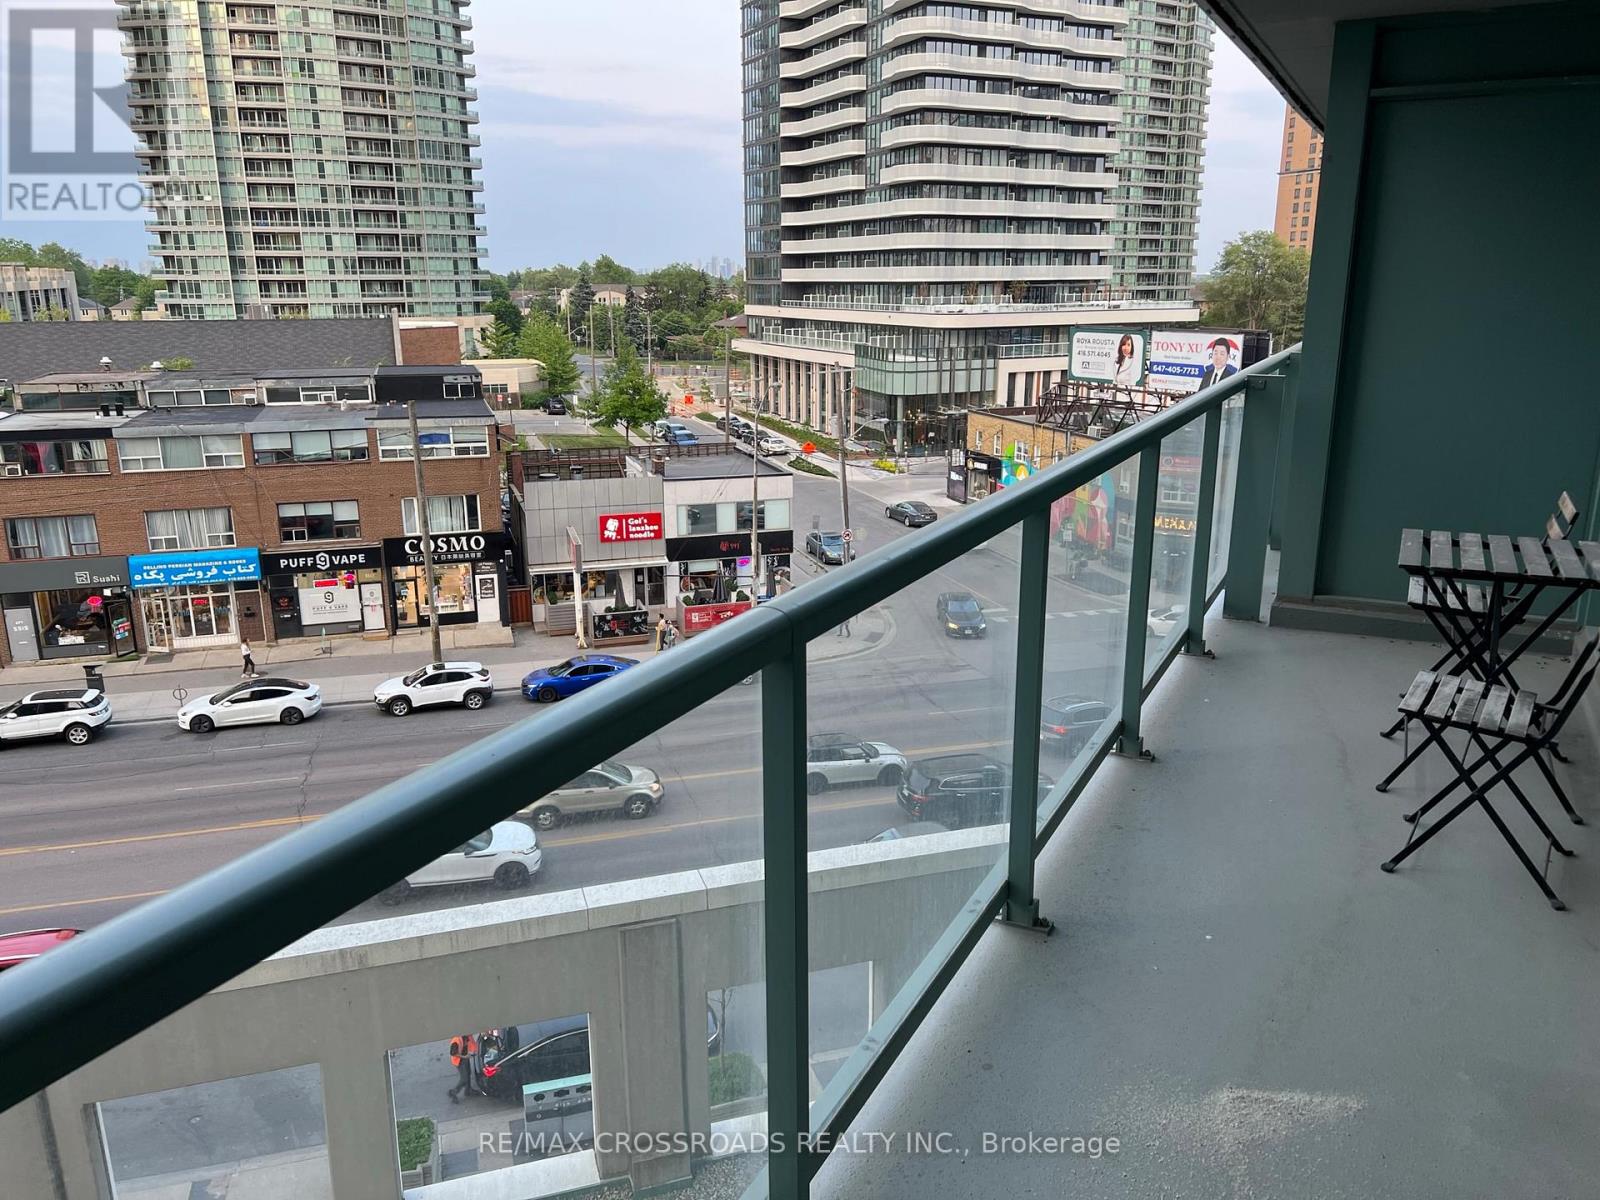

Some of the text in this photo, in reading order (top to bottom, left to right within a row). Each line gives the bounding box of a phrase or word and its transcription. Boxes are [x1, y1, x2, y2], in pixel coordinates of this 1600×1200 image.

[1154, 341, 1203, 353] TONY XU
[404, 535, 486, 554] COSMO
[280, 557, 314, 568] PUFF
[332, 554, 366, 565] VAPE
[93, 574, 121, 583] Sushi
